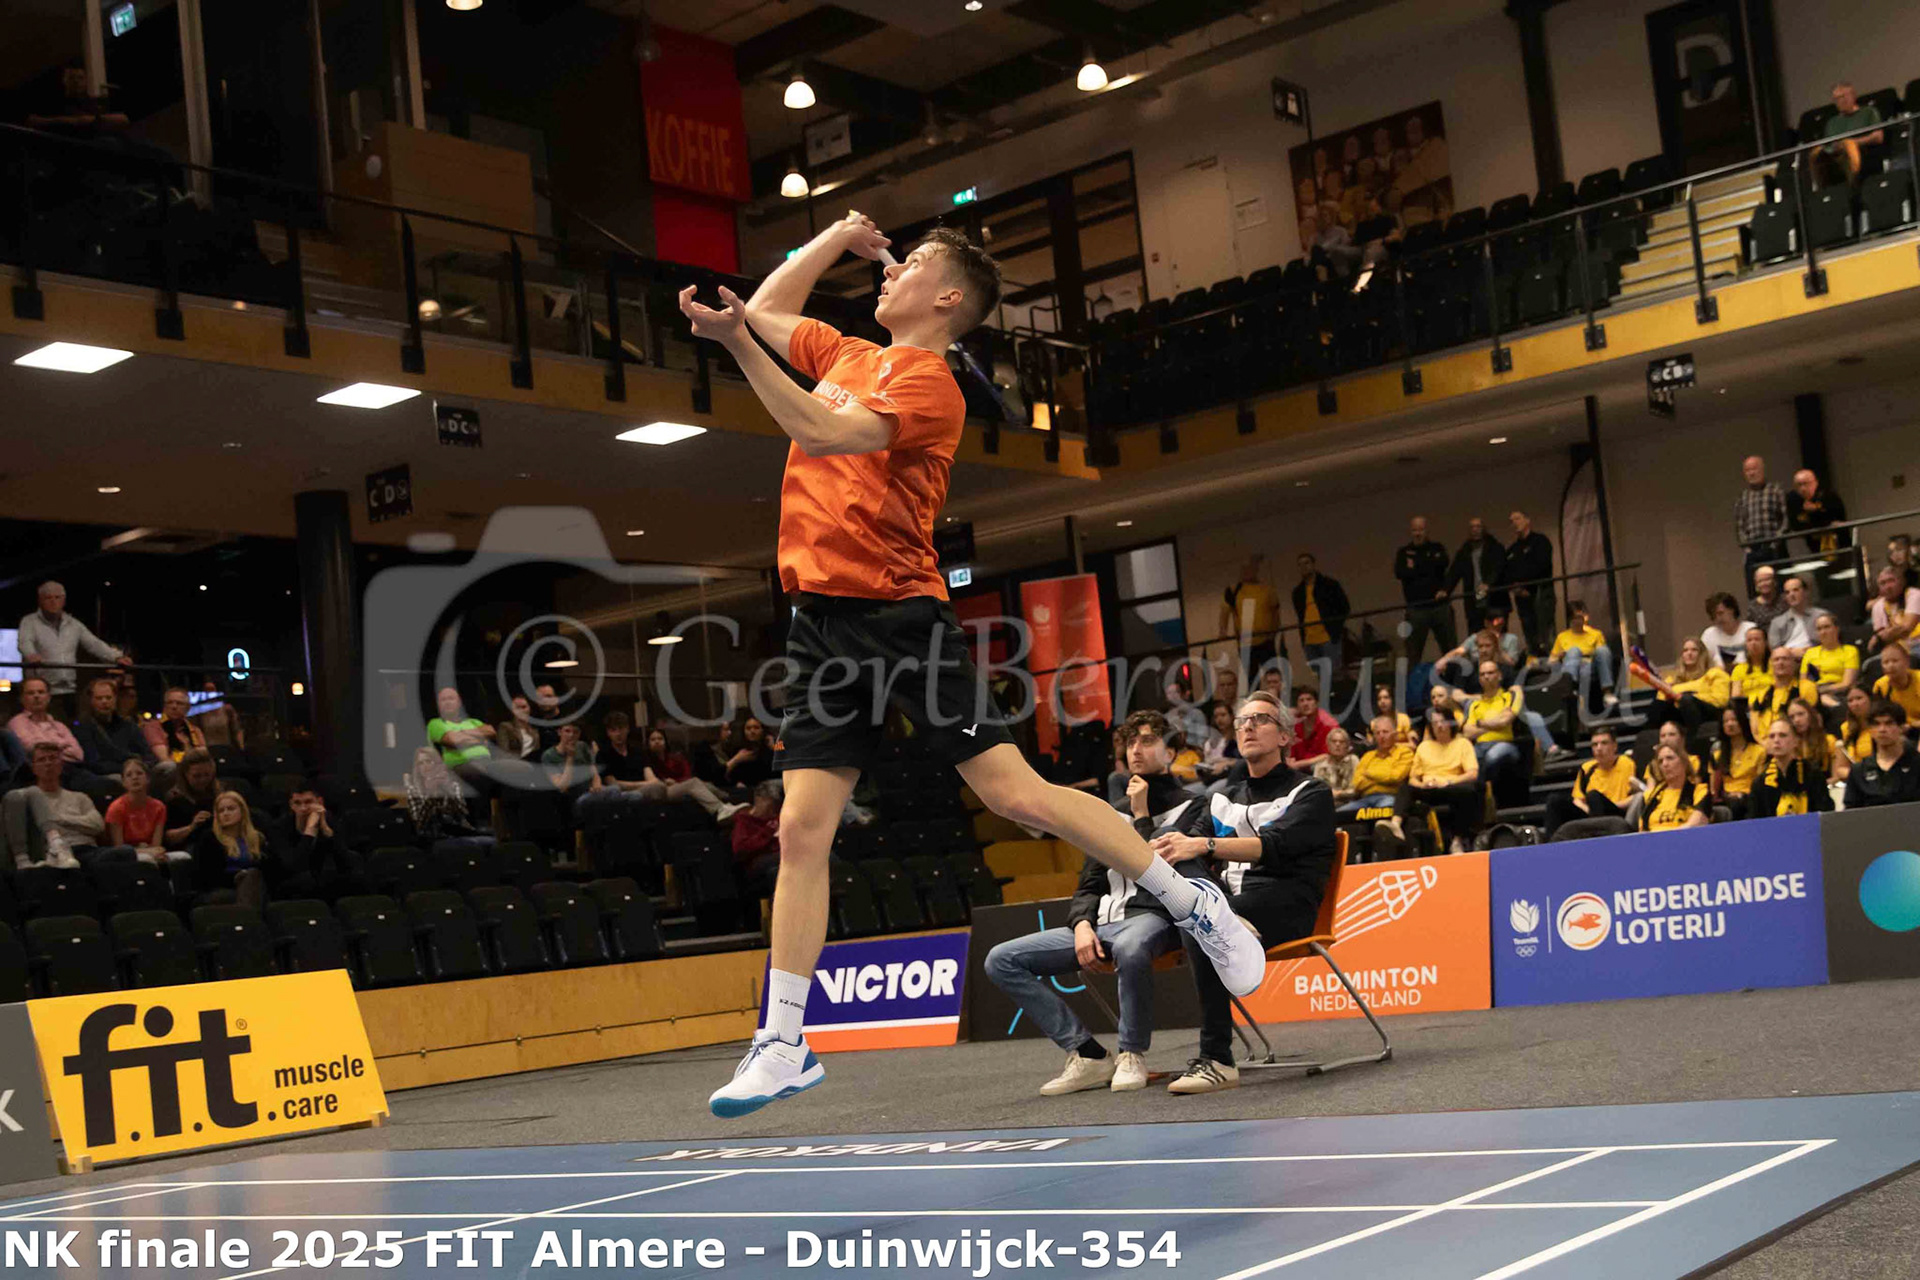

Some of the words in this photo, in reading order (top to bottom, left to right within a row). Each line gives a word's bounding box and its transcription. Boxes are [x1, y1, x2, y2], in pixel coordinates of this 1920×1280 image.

[646, 106, 734, 193] KOFFIE
[1613, 872, 1807, 915] NEDERLANDSE
[1615, 911, 1726, 945] LOTERIJ
[815, 958, 958, 1004] VICTOR
[1294, 965, 1438, 995] BADMINTON
[1310, 989, 1422, 1012] NEDERLAND
[274, 1055, 365, 1089] muscle
